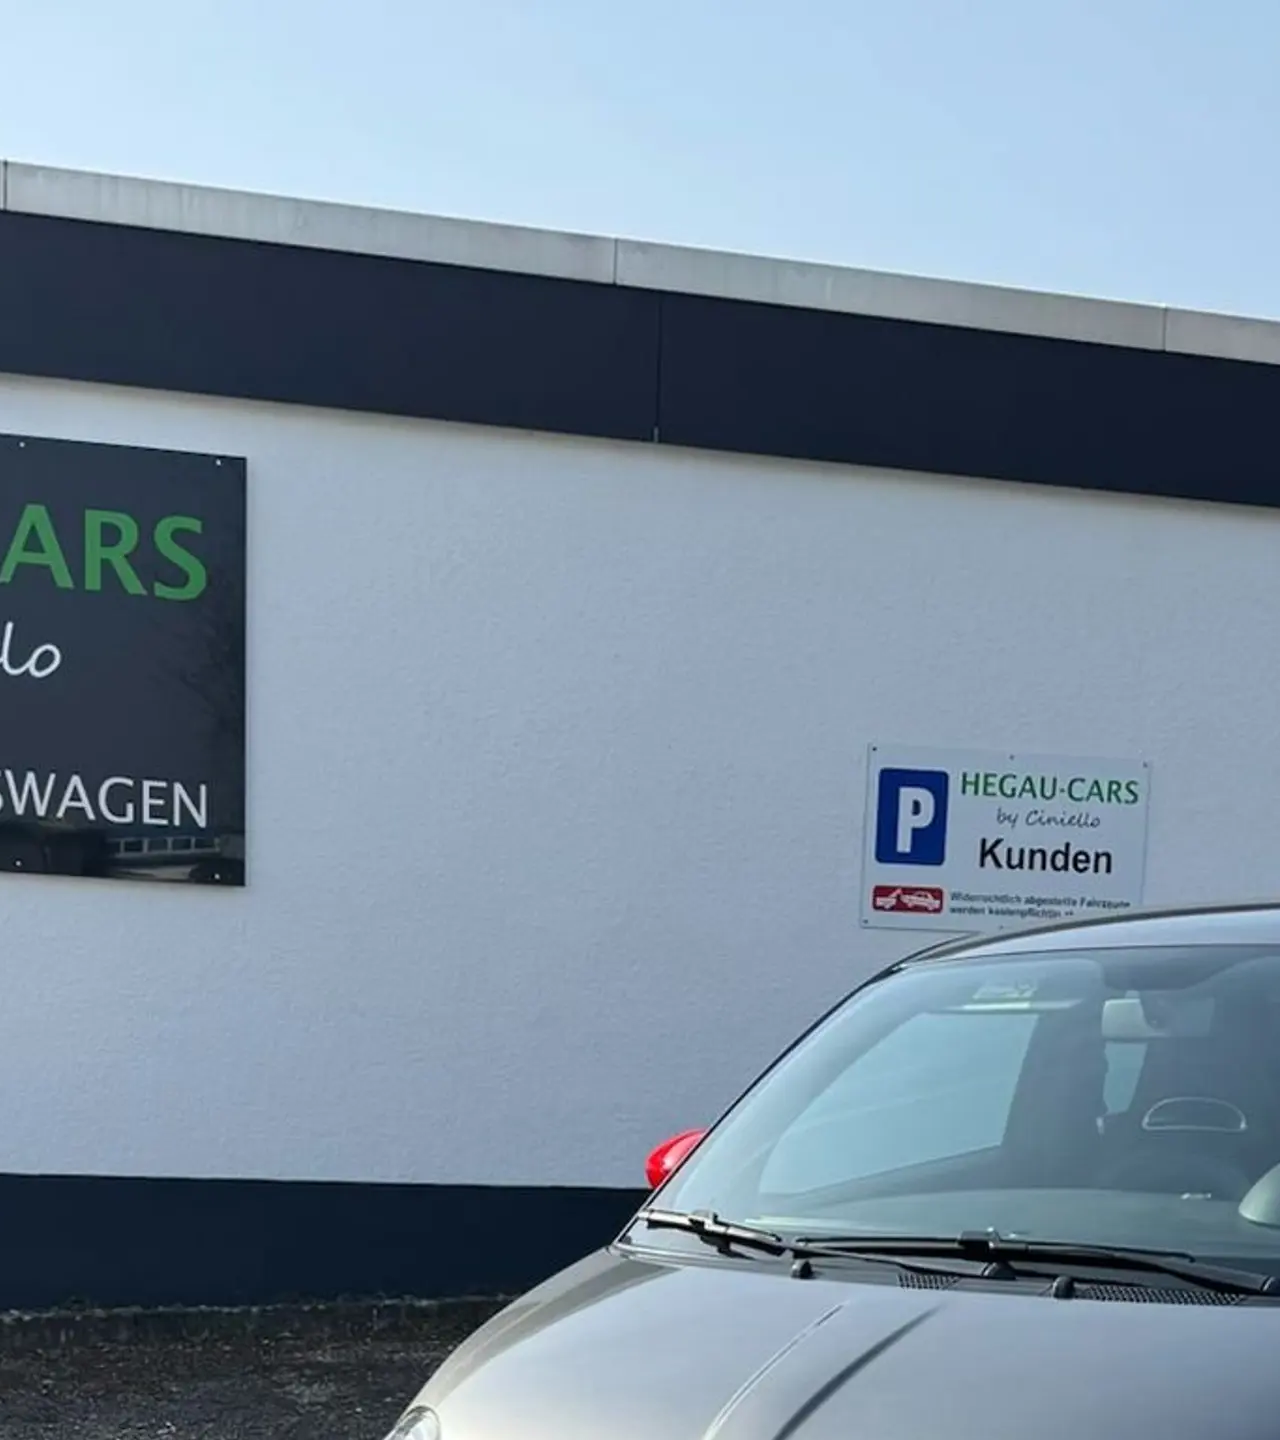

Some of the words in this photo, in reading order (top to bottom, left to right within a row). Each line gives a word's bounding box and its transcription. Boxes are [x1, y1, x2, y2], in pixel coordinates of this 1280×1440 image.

[960, 772, 1139, 804] HEGAU-CARS
[896, 786, 935, 853] P
[996, 807, 1018, 828] by
[1025, 810, 1101, 828] Ciniello
[979, 838, 1112, 874] Kunden
